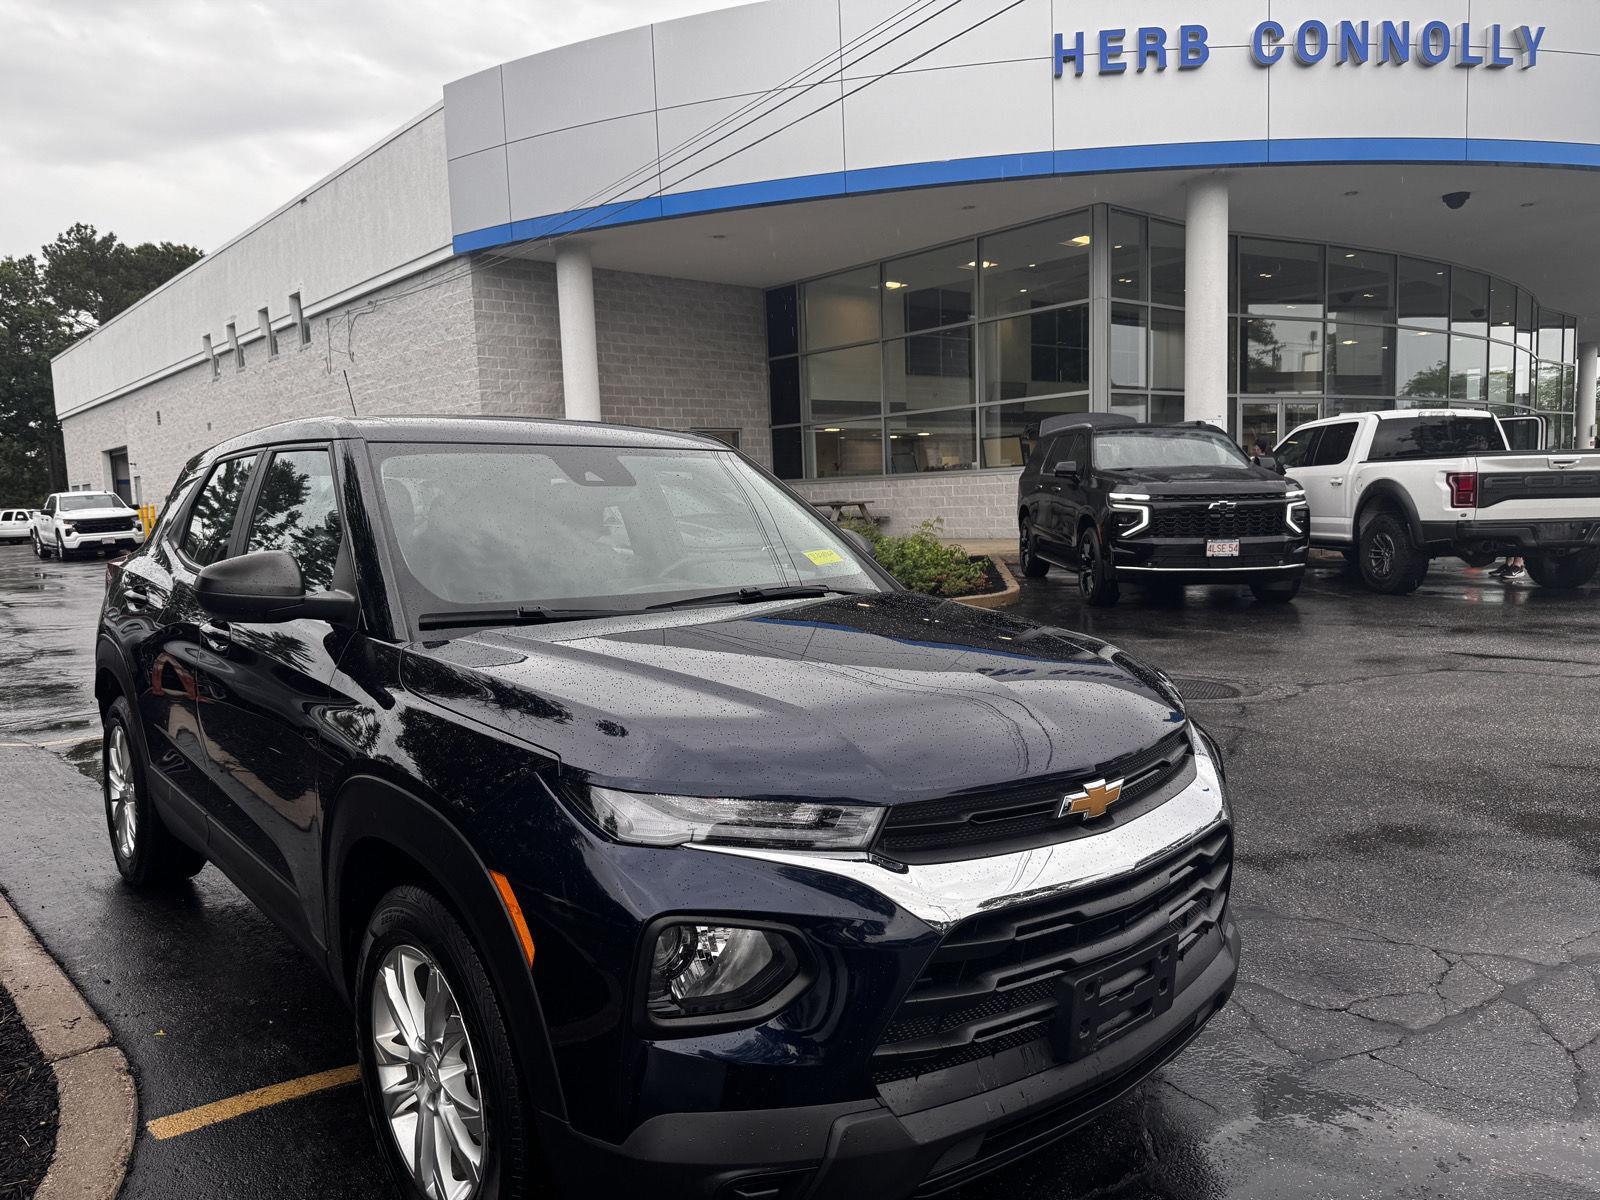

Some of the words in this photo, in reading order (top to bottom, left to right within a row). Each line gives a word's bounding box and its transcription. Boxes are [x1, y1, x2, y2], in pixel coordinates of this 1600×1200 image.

[1054, 25, 1210, 78] HERB
[1251, 19, 1546, 69] CONNOLLY
[1484, 475, 1600, 488] FOR
[1208, 544, 1226, 553] 4LSE
[1229, 544, 1238, 552] 54
